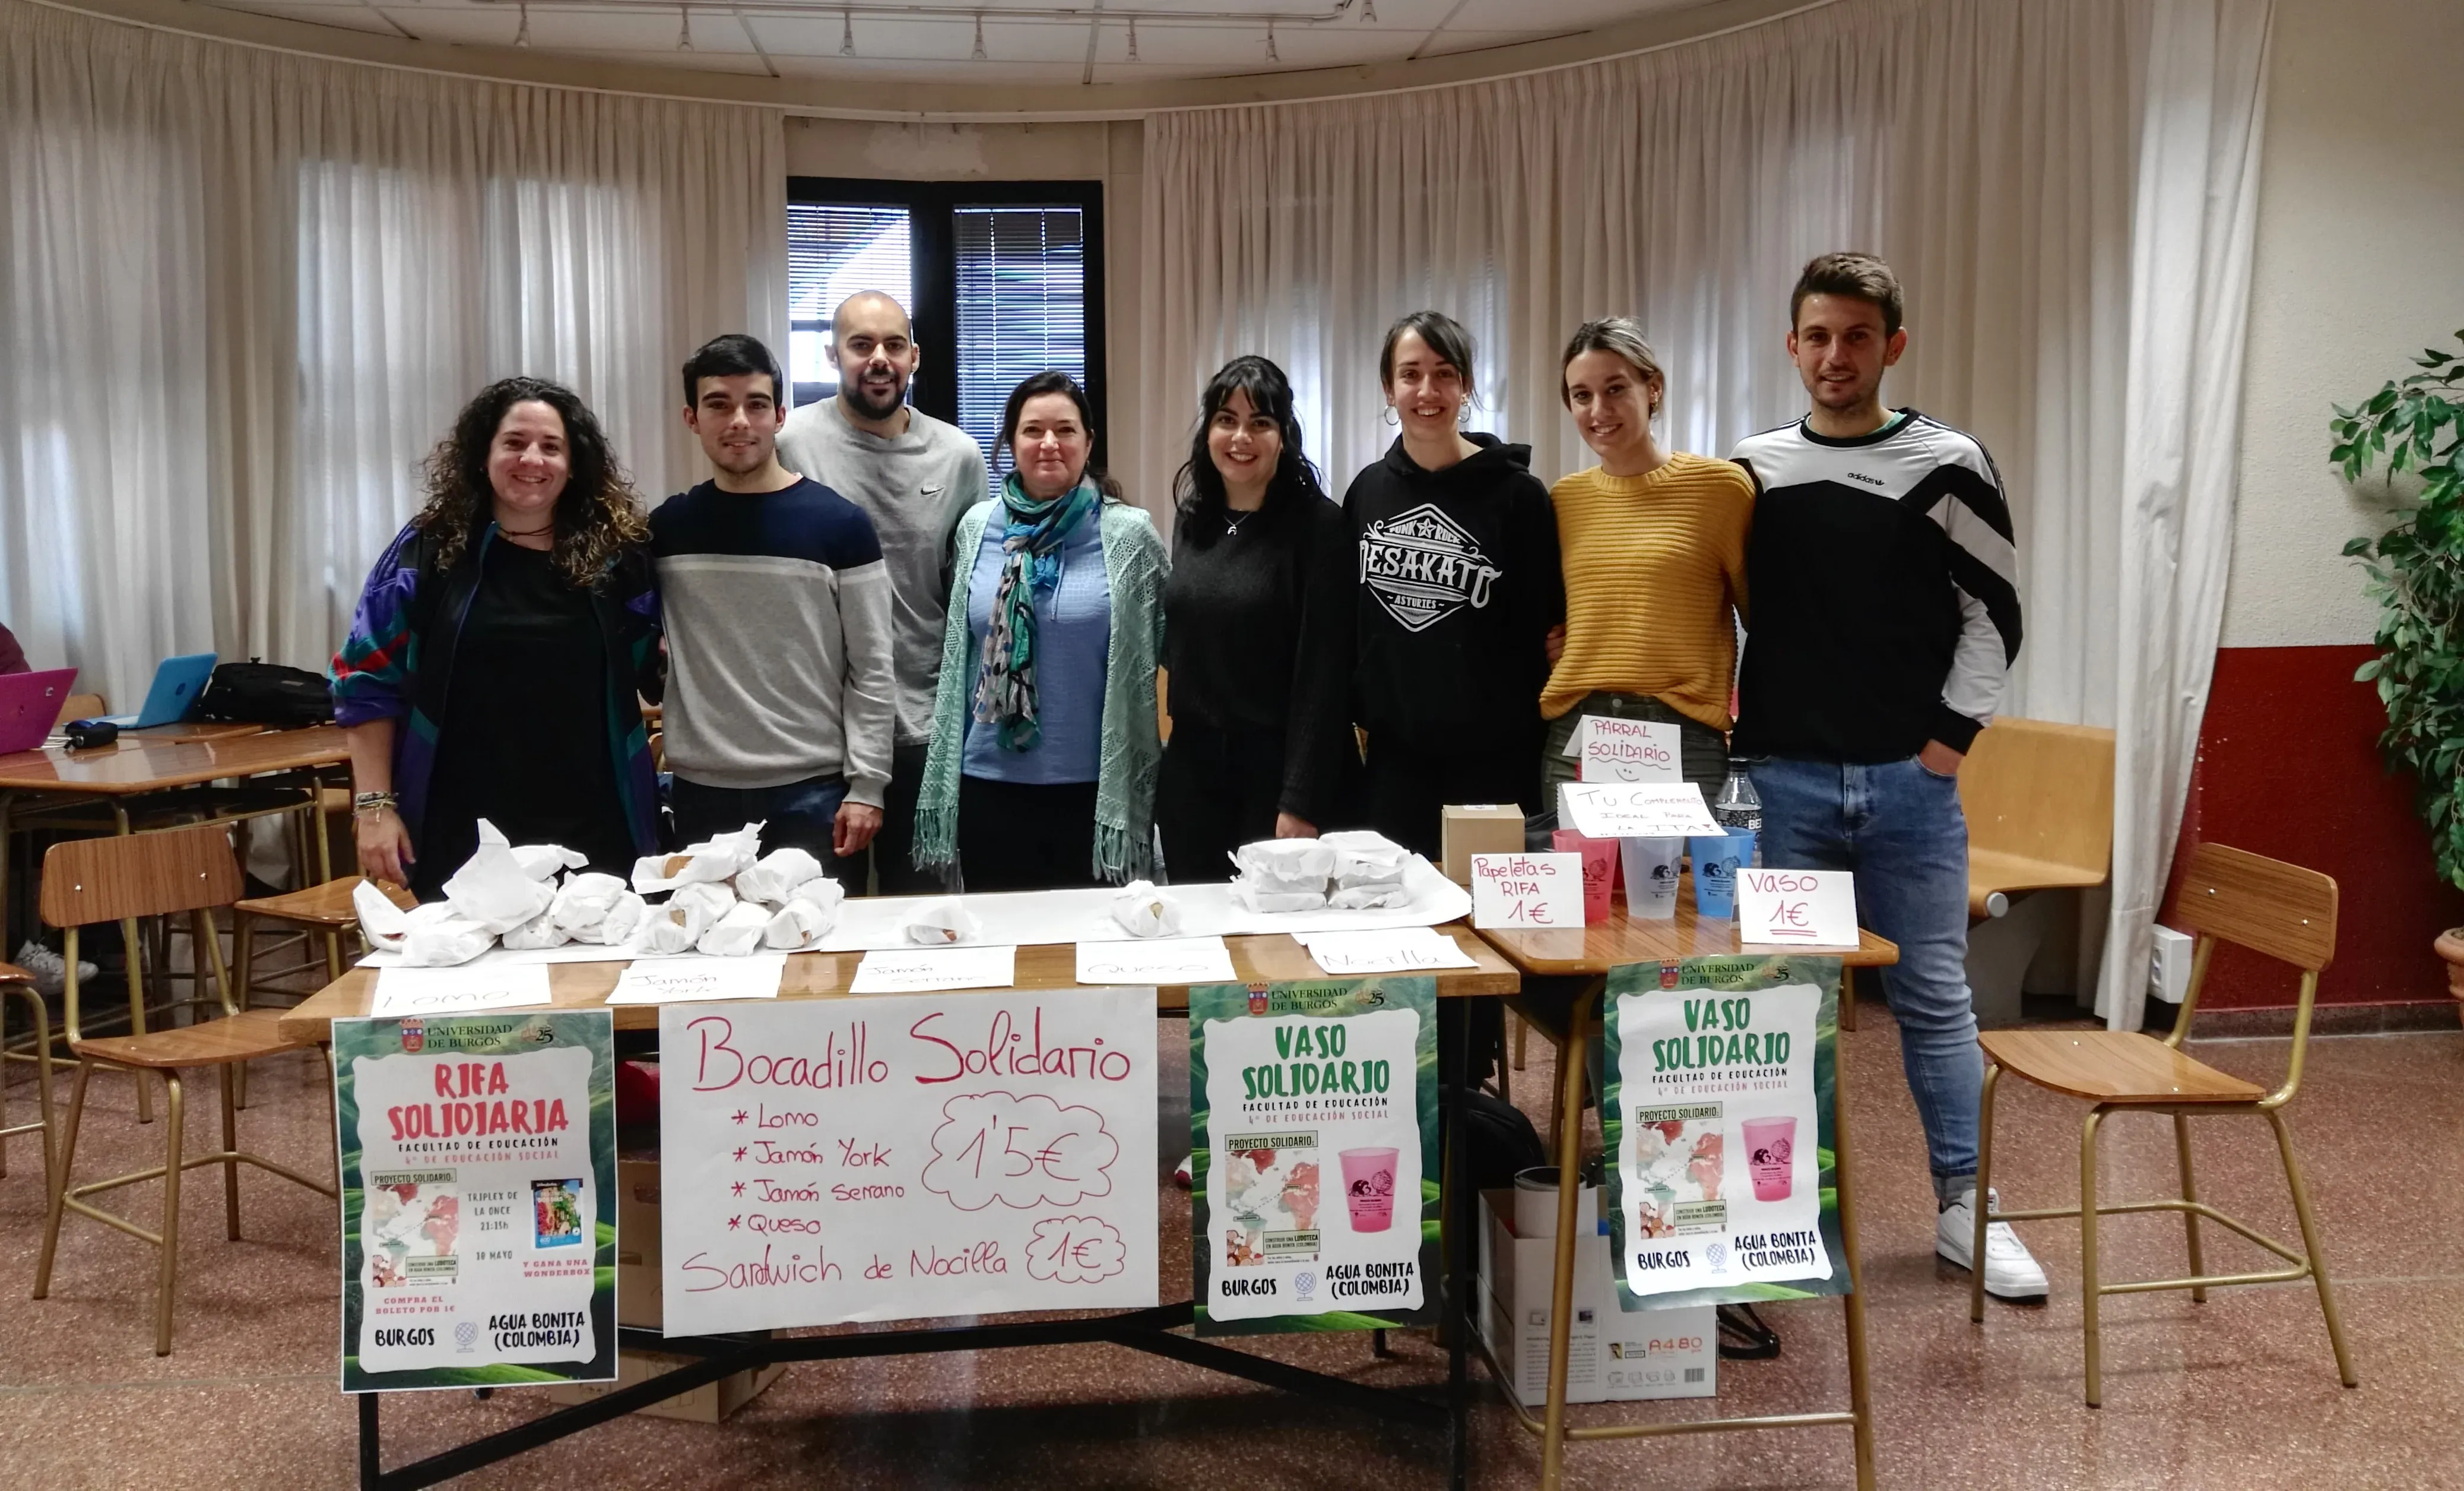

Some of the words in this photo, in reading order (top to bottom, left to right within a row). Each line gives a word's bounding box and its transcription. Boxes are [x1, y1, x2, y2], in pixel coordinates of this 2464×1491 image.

[1847, 473, 1874, 484] adidas
[1389, 520, 1417, 536] PUNK
[1434, 524, 1461, 544] ROCK
[1394, 595, 1436, 609] ASTURIES
[1590, 720, 1652, 738] PARRAL
[1577, 790, 1617, 806] TU
[1474, 856, 1556, 883] Papeletas
[1501, 881, 1540, 897] RIFA
[1769, 901, 1809, 927] 1€
[1324, 950, 1450, 966] Nocilla
[865, 964, 933, 974] Jamón
[1088, 963, 1208, 974] Queso
[1682, 963, 1755, 974] UNIVERSIDAD
[630, 974, 716, 986] Jamón
[1681, 977, 1696, 985] DE
[1700, 974, 1744, 984] BURGOS
[1271, 988, 1347, 1000] UNIVERSIDAD
[1368, 992, 1385, 1006] 25
[1271, 1002, 1287, 1011] DE
[1291, 1000, 1337, 1010] BURGOS
[1684, 998, 1751, 1033] VASO
[427, 1024, 513, 1037] UNIVERSIDAD
[535, 1029, 554, 1043] 25
[428, 1039, 445, 1048] DE
[449, 1037, 501, 1048] BURGOS
[1275, 1024, 1346, 1060] VASO
[687, 1016, 889, 1091] Bocadillo
[910, 1006, 1130, 1085] Solidario
[1652, 1031, 1791, 1072] SOLIDARIO
[435, 1062, 509, 1099] RIFA
[1242, 1060, 1390, 1100] SOLIDARIO
[1653, 1072, 1704, 1084] FACULTAD
[1711, 1072, 1722, 1080] DE
[1729, 1067, 1787, 1079] EDUCACIÓN
[1674, 1086, 1685, 1094] DE
[1692, 1082, 1747, 1093] EDUCACIÓN
[1754, 1081, 1788, 1090] SOCIAL
[1243, 1101, 1298, 1112] FACULTAD
[1306, 1100, 1318, 1109] DE
[1325, 1096, 1387, 1108] EDUCACIÓN
[387, 1098, 569, 1141] SOLIDIARIA
[759, 1103, 819, 1128] Lomo
[1266, 1115, 1278, 1123] DE
[1285, 1111, 1345, 1122] EDUCACIÓN
[1352, 1110, 1388, 1120] SOCIAL
[1640, 1109, 1676, 1121] PROYECTO
[1679, 1107, 1719, 1118] SOLIDARIO:
[398, 1141, 460, 1153] FACULTAD
[468, 1141, 481, 1150] DE
[489, 1137, 559, 1149] EDUCACIÓN
[1229, 1138, 1269, 1150] PROYECTO
[1271, 1136, 1315, 1147] SOLIDARIO:
[424, 1156, 437, 1164] DE
[445, 1151, 511, 1163] EDUCACIÓN
[519, 1151, 559, 1161] SOCIAL
[753, 1140, 823, 1166] Jamón
[838, 1138, 890, 1168] York
[374, 1175, 411, 1184] PROYECTO
[468, 1193, 504, 1202] TRIPLEX
[753, 1180, 820, 1202] Jamón
[832, 1183, 904, 1200] Serrano
[475, 1207, 485, 1215] LA
[489, 1207, 510, 1215] ONCE
[747, 1213, 821, 1235] Queso
[1734, 1235, 1767, 1251] AGUA
[1771, 1231, 1816, 1248] BONITA
[490, 1250, 513, 1260] MAYO
[1048, 1232, 1102, 1269] 1€
[1742, 1248, 1816, 1271] (COLOMBIA)
[683, 1243, 842, 1291] Sandwich
[864, 1255, 893, 1280] de
[911, 1242, 1007, 1278] Nocilla
[1638, 1251, 1691, 1270] BURGOS
[524, 1268, 591, 1277] WONDERBOX
[1326, 1265, 1361, 1280] AGUA
[1366, 1262, 1414, 1278] BONITA
[1222, 1279, 1277, 1297] BURGOS
[1331, 1280, 1410, 1300] (COLOMBIA)
[384, 1296, 427, 1305] COMPRA
[376, 1306, 415, 1315] BOLETO
[489, 1315, 527, 1330] AGUA
[532, 1312, 585, 1328] BONITA
[375, 1328, 435, 1346] BURGOS
[494, 1329, 580, 1351] (COLOMBIA)
